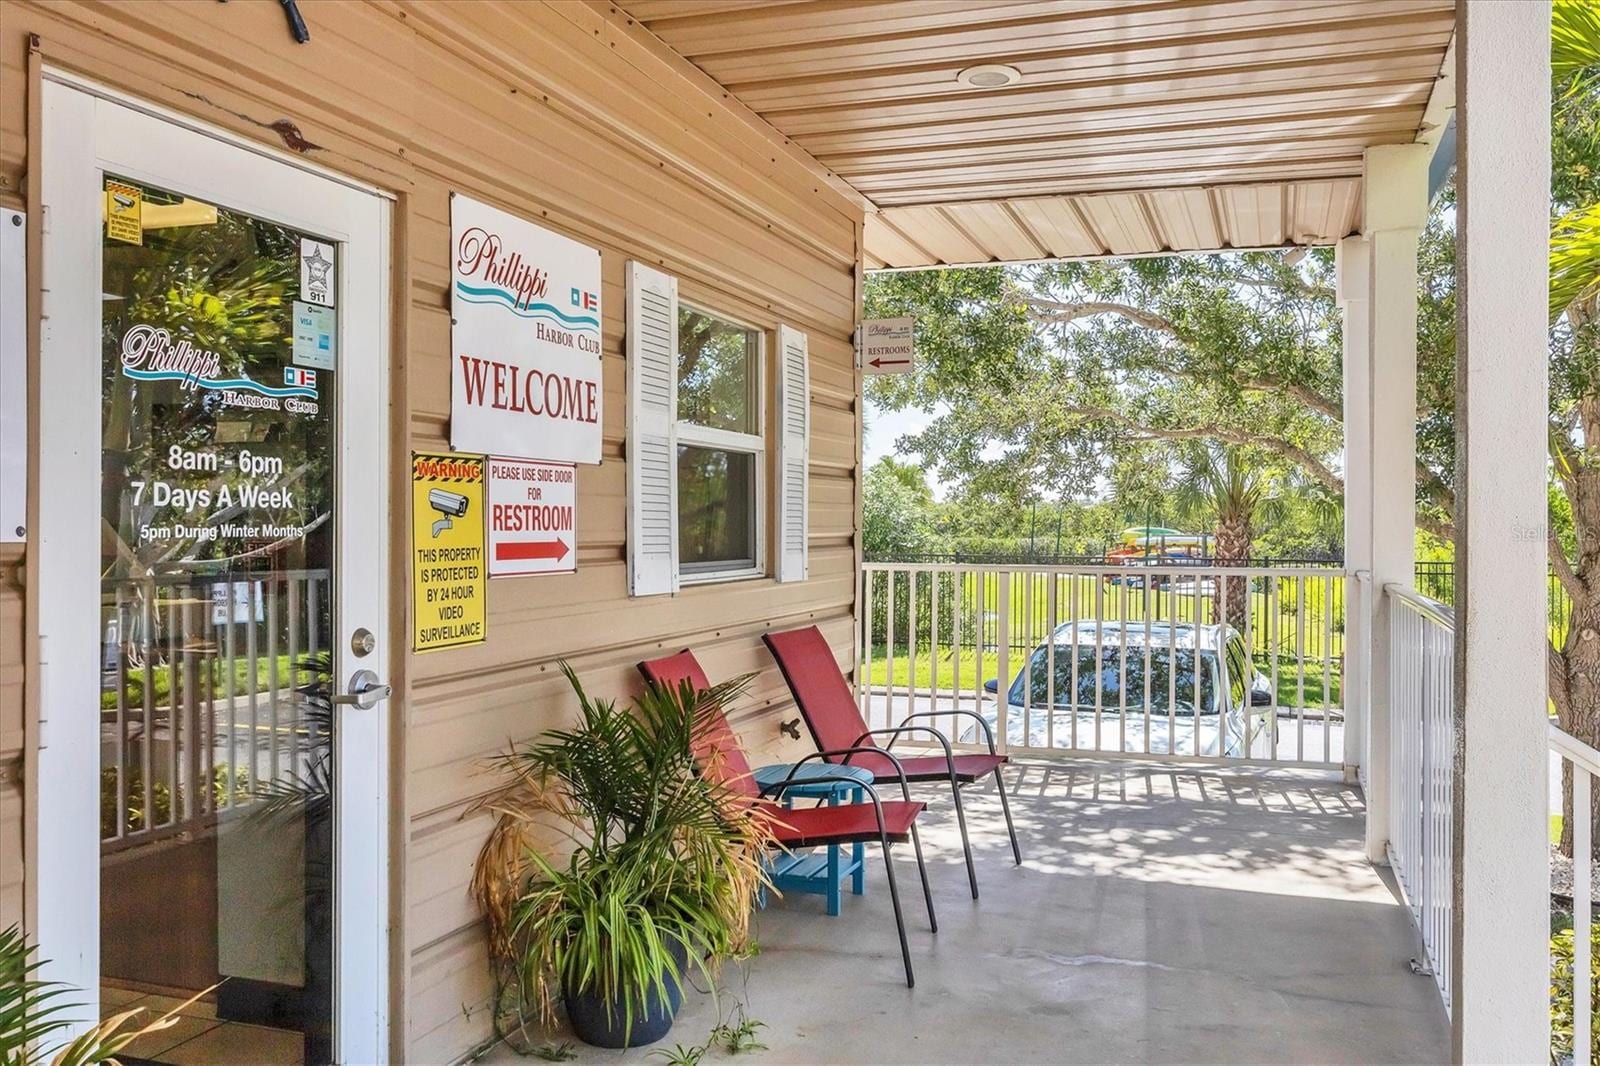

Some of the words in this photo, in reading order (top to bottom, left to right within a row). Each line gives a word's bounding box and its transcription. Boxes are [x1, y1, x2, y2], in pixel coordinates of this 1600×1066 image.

[457, 227, 548, 311] Phillippi
[310, 292, 325, 303] 911
[536, 322, 574, 348] HARBOR
[578, 334, 600, 354] CLUB
[121, 325, 220, 390] Phillippi
[868, 345, 910, 355] RESTROOMS
[460, 355, 598, 424] WELCOME
[222, 391, 280, 410] HARBOR
[285, 398, 318, 414] CLUB
[168, 444, 217, 471] 8am
[239, 450, 283, 478] 6pm
[416, 462, 481, 479] WARNING
[492, 465, 520, 481] PLEASE
[522, 468, 536, 482] USE
[537, 469, 553, 483] SIDE
[554, 470, 573, 483] DOOR
[130, 482, 146, 506] 7
[153, 482, 210, 512] Days
[216, 485, 233, 507] A
[239, 485, 293, 509] Week
[528, 488, 542, 500] FOR
[493, 504, 572, 532] RESTROOM
[140, 524, 170, 540] 5pm
[174, 525, 217, 541] During
[220, 524, 259, 538] Winter
[262, 524, 303, 538] Months
[418, 549, 437, 563] THIS
[439, 547, 481, 561] PROPERTY
[421, 569, 429, 583] IS
[431, 566, 479, 582] PROTECTED
[427, 588, 438, 602] BY
[440, 587, 450, 601] 24
[451, 585, 474, 600] HOUR
[439, 605, 463, 620] VIDEO
[420, 622, 480, 643] SURVEILLANCE
